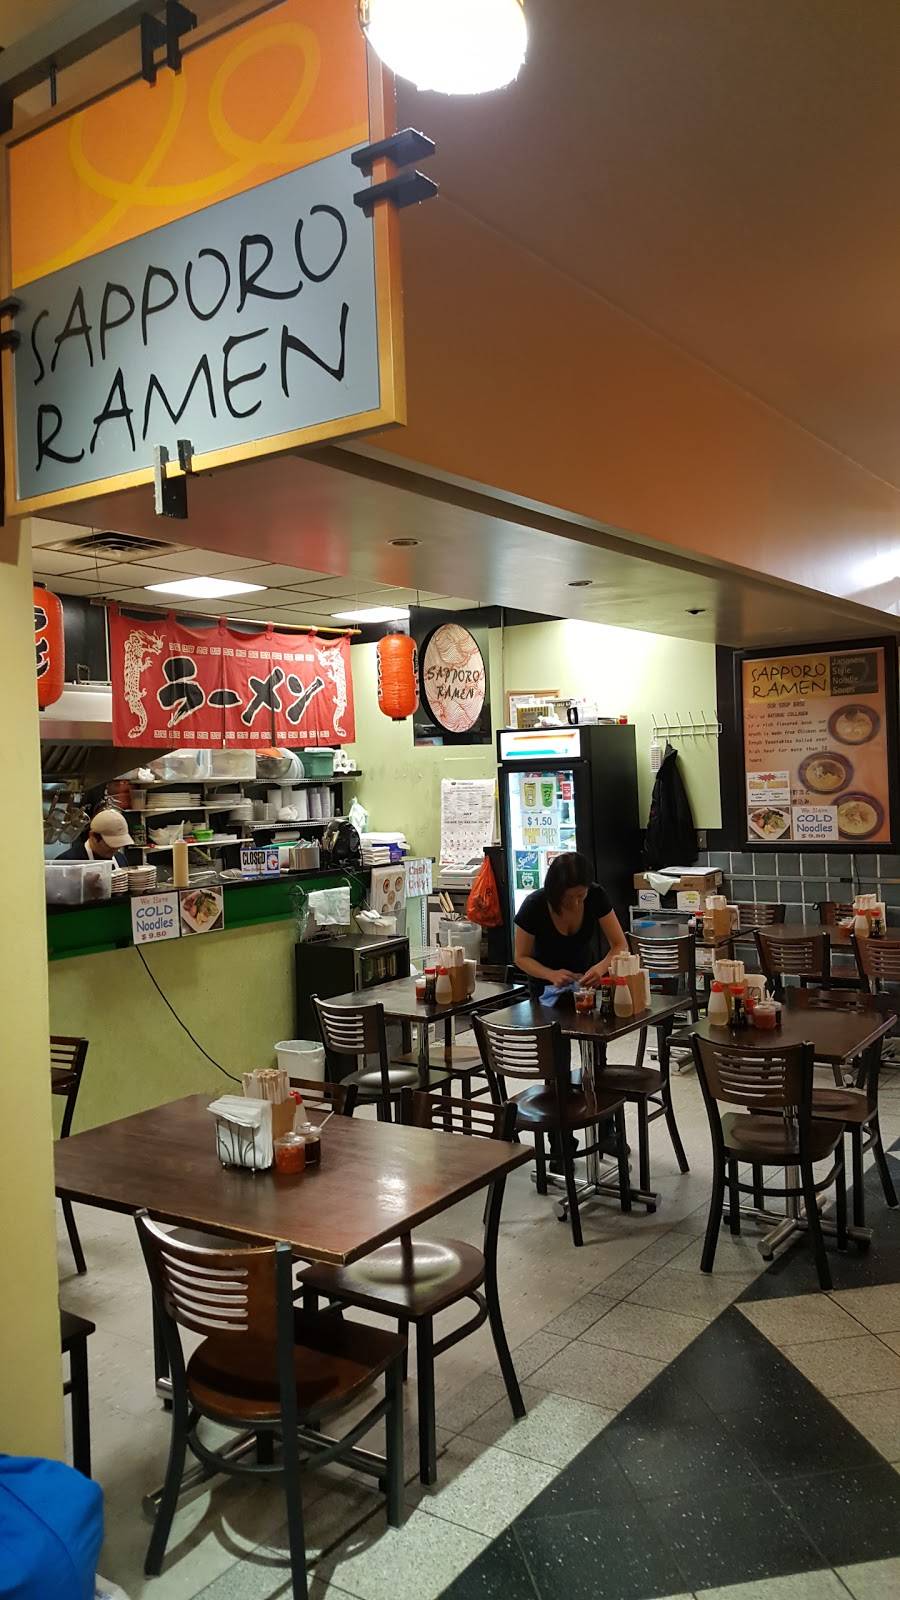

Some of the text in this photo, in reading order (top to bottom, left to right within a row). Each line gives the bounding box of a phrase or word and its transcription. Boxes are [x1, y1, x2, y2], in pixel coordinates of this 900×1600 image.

[33, 204, 348, 386] SAPPORO
[35, 302, 350, 472] RAMEN
[427, 665, 480, 684] SAPPORO
[752, 663, 825, 682] SAPPORO
[832, 666, 853, 676] Style
[157, 655, 325, 728] ラーメン
[436, 685, 474, 700] RAMEN
[752, 679, 827, 698] RAMEN
[797, 824, 832, 832] Noodles
[136, 904, 173, 919] COLD
[136, 917, 174, 932] Noodles
